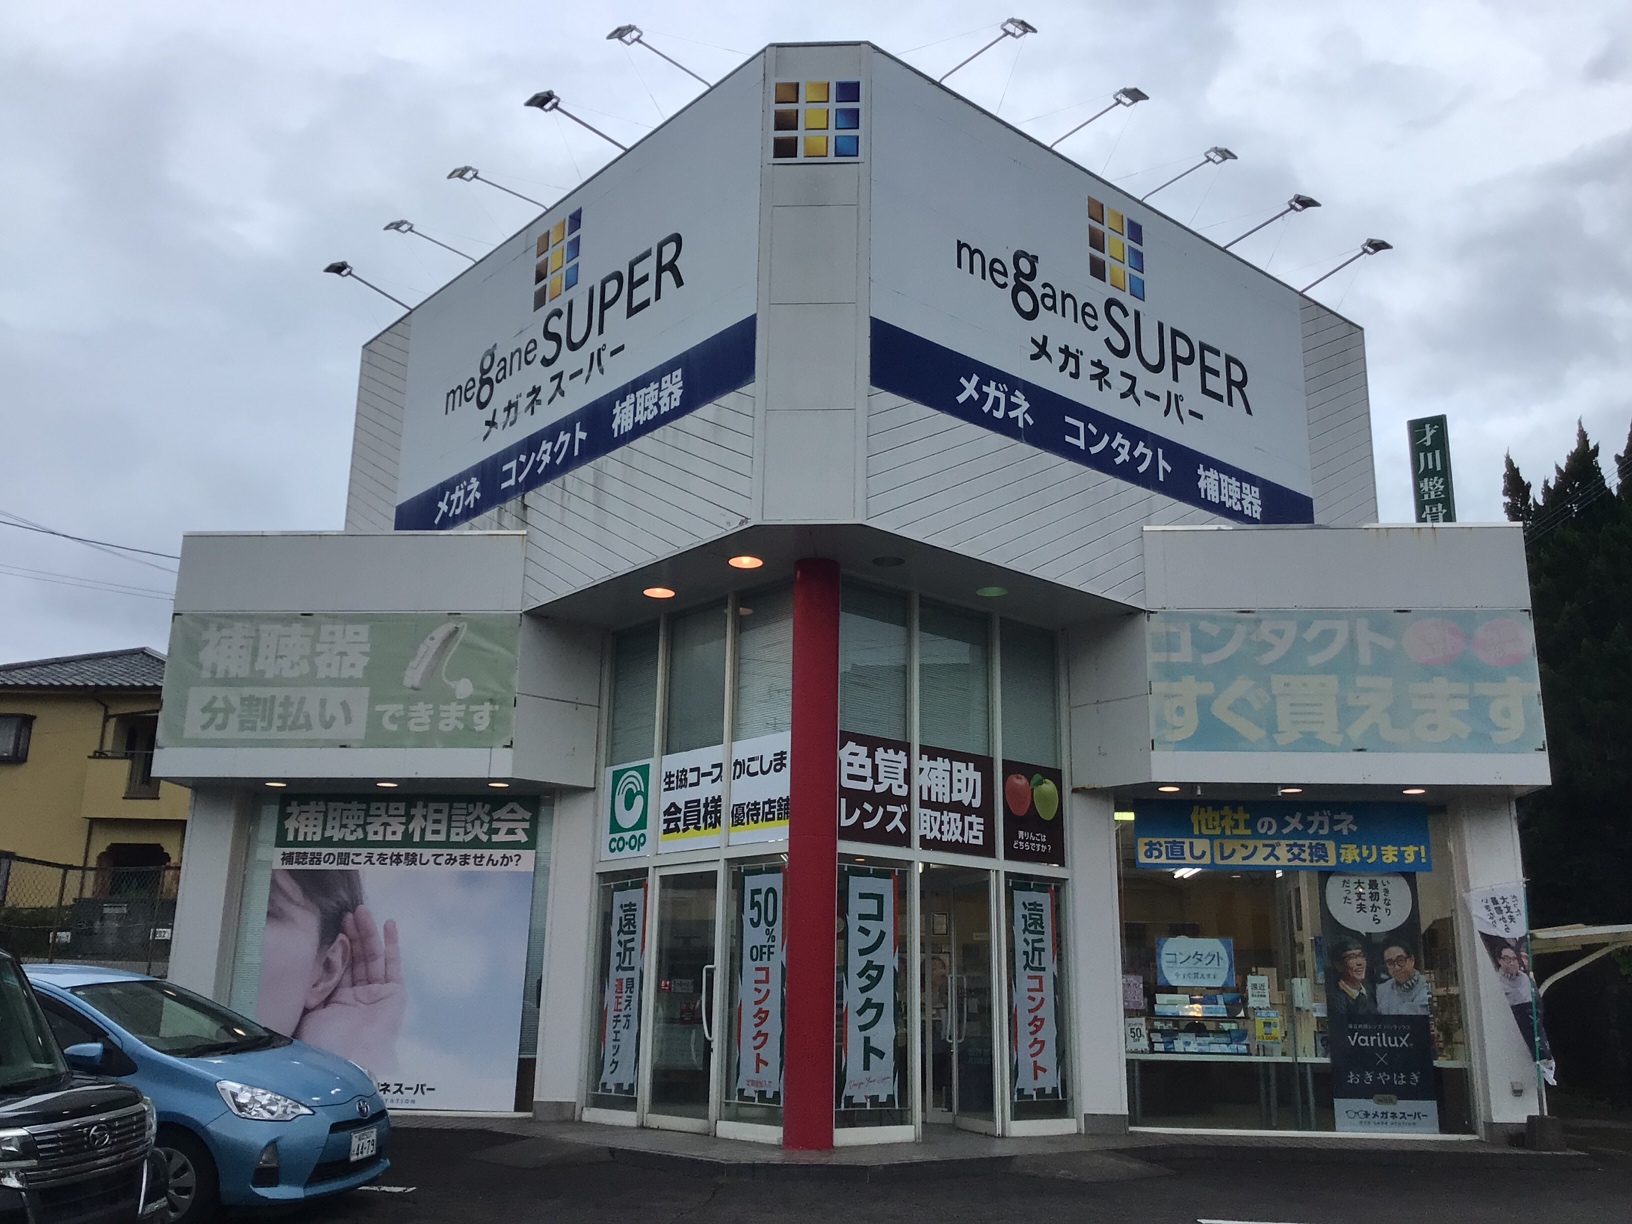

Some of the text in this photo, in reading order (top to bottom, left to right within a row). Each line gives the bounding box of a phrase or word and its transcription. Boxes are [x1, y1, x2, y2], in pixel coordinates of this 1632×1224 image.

[482, 344, 626, 442] メガネスーパー
[1029, 335, 1204, 425] メガネスーパー
[433, 367, 684, 525] メガネ コンタクト 補聴器
[955, 372, 1263, 520] メガネ コンタクト 補聴器
[199, 623, 371, 680] 補聴器
[1150, 617, 1397, 667] コンタクト
[200, 694, 500, 733] 分割払い できます
[1150, 674, 1541, 746] すぐ買えます
[732, 750, 787, 781] かごしま
[284, 801, 533, 844] 補聴器相談会
[662, 795, 722, 836] 会員様
[1190, 805, 1359, 837] 他社のメガネ
[1142, 838, 1207, 861] お直し
[1218, 840, 1330, 864] レンズ交換
[1341, 879, 1353, 905] だった
[1353, 879, 1368, 914] 大丈夫
[1367, 879, 1382, 926] 最初から
[1381, 879, 1392, 917] いきなり
[615, 901, 637, 973] 遠近
[749, 944, 775, 963] OFF
[1165, 950, 1224, 967] コンタクト
[856, 892, 886, 1072] コンタクト
[622, 977, 635, 1031] 見え方
[752, 966, 771, 1075] コンタクト
[377, 1082, 436, 1096] ネスーパー
[1346, 1070, 1421, 1086] おぎやはぎ
[1371, 1109, 1429, 1121] メガネスーパー
